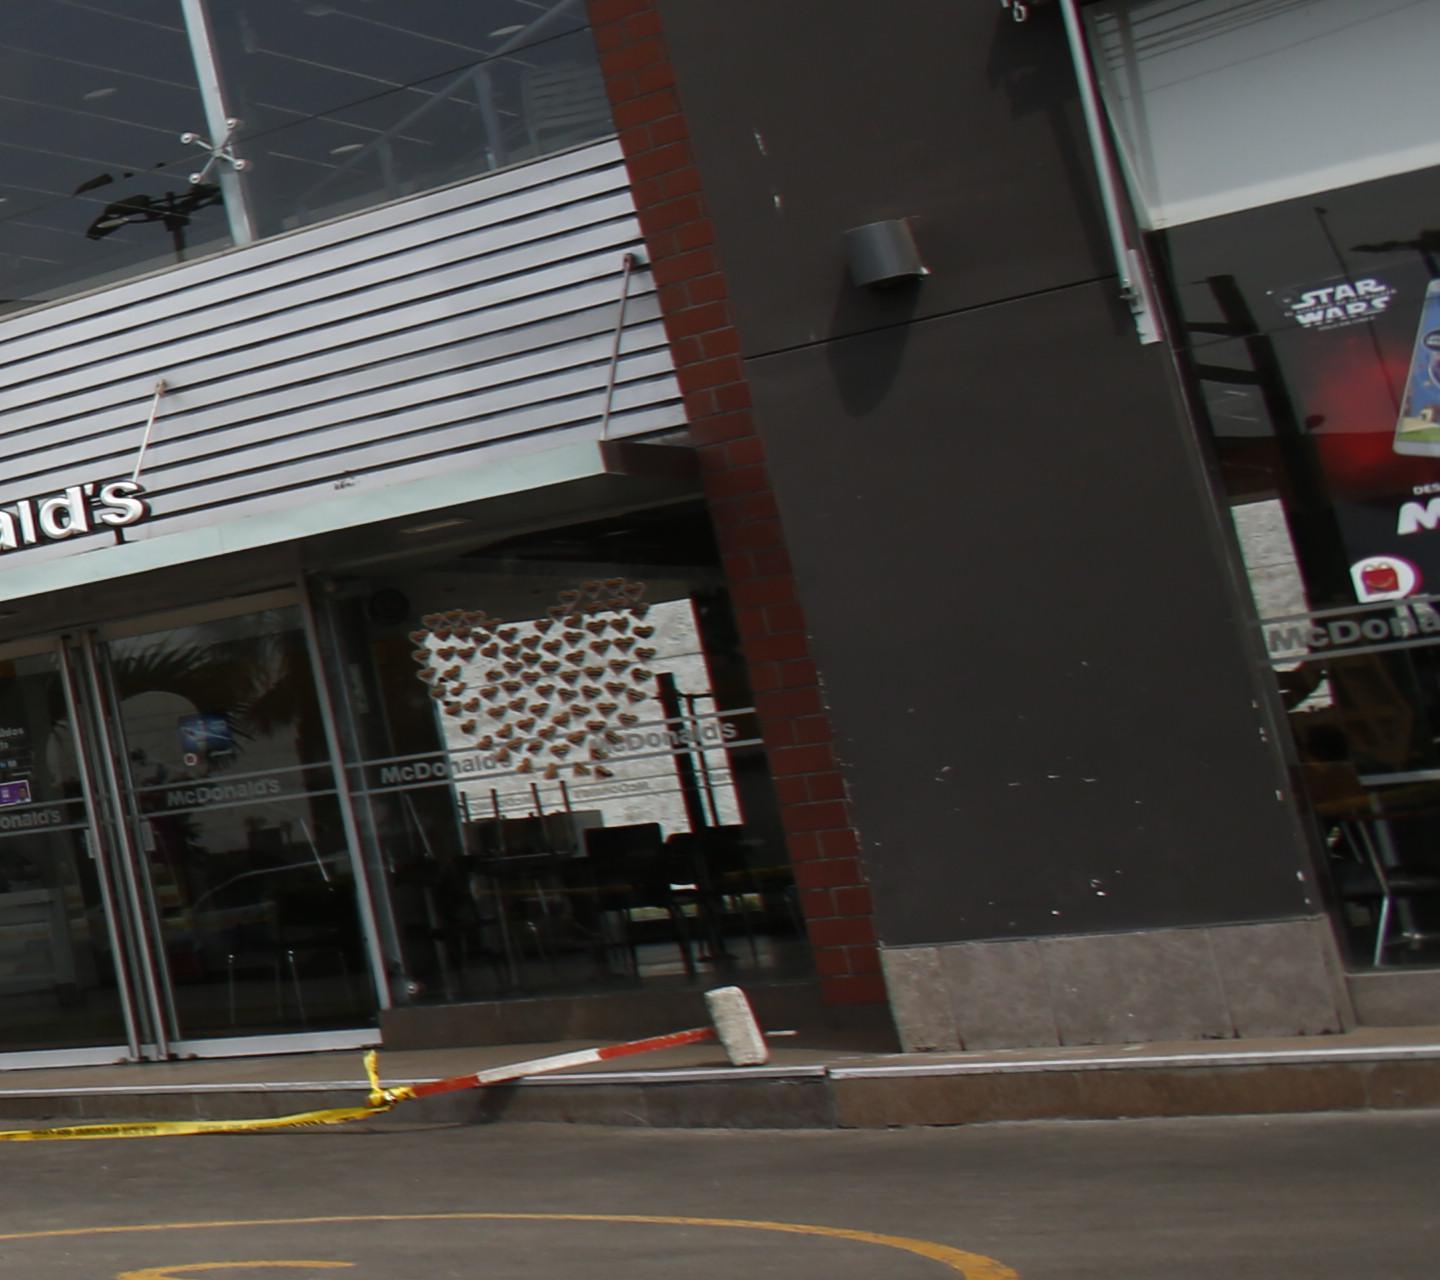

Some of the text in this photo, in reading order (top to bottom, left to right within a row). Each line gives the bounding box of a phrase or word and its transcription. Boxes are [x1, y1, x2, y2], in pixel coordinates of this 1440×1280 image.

[1291, 278, 1386, 310] STAR
[1268, 604, 1440, 652] McDona
[167, 778, 280, 808] McDonald's
